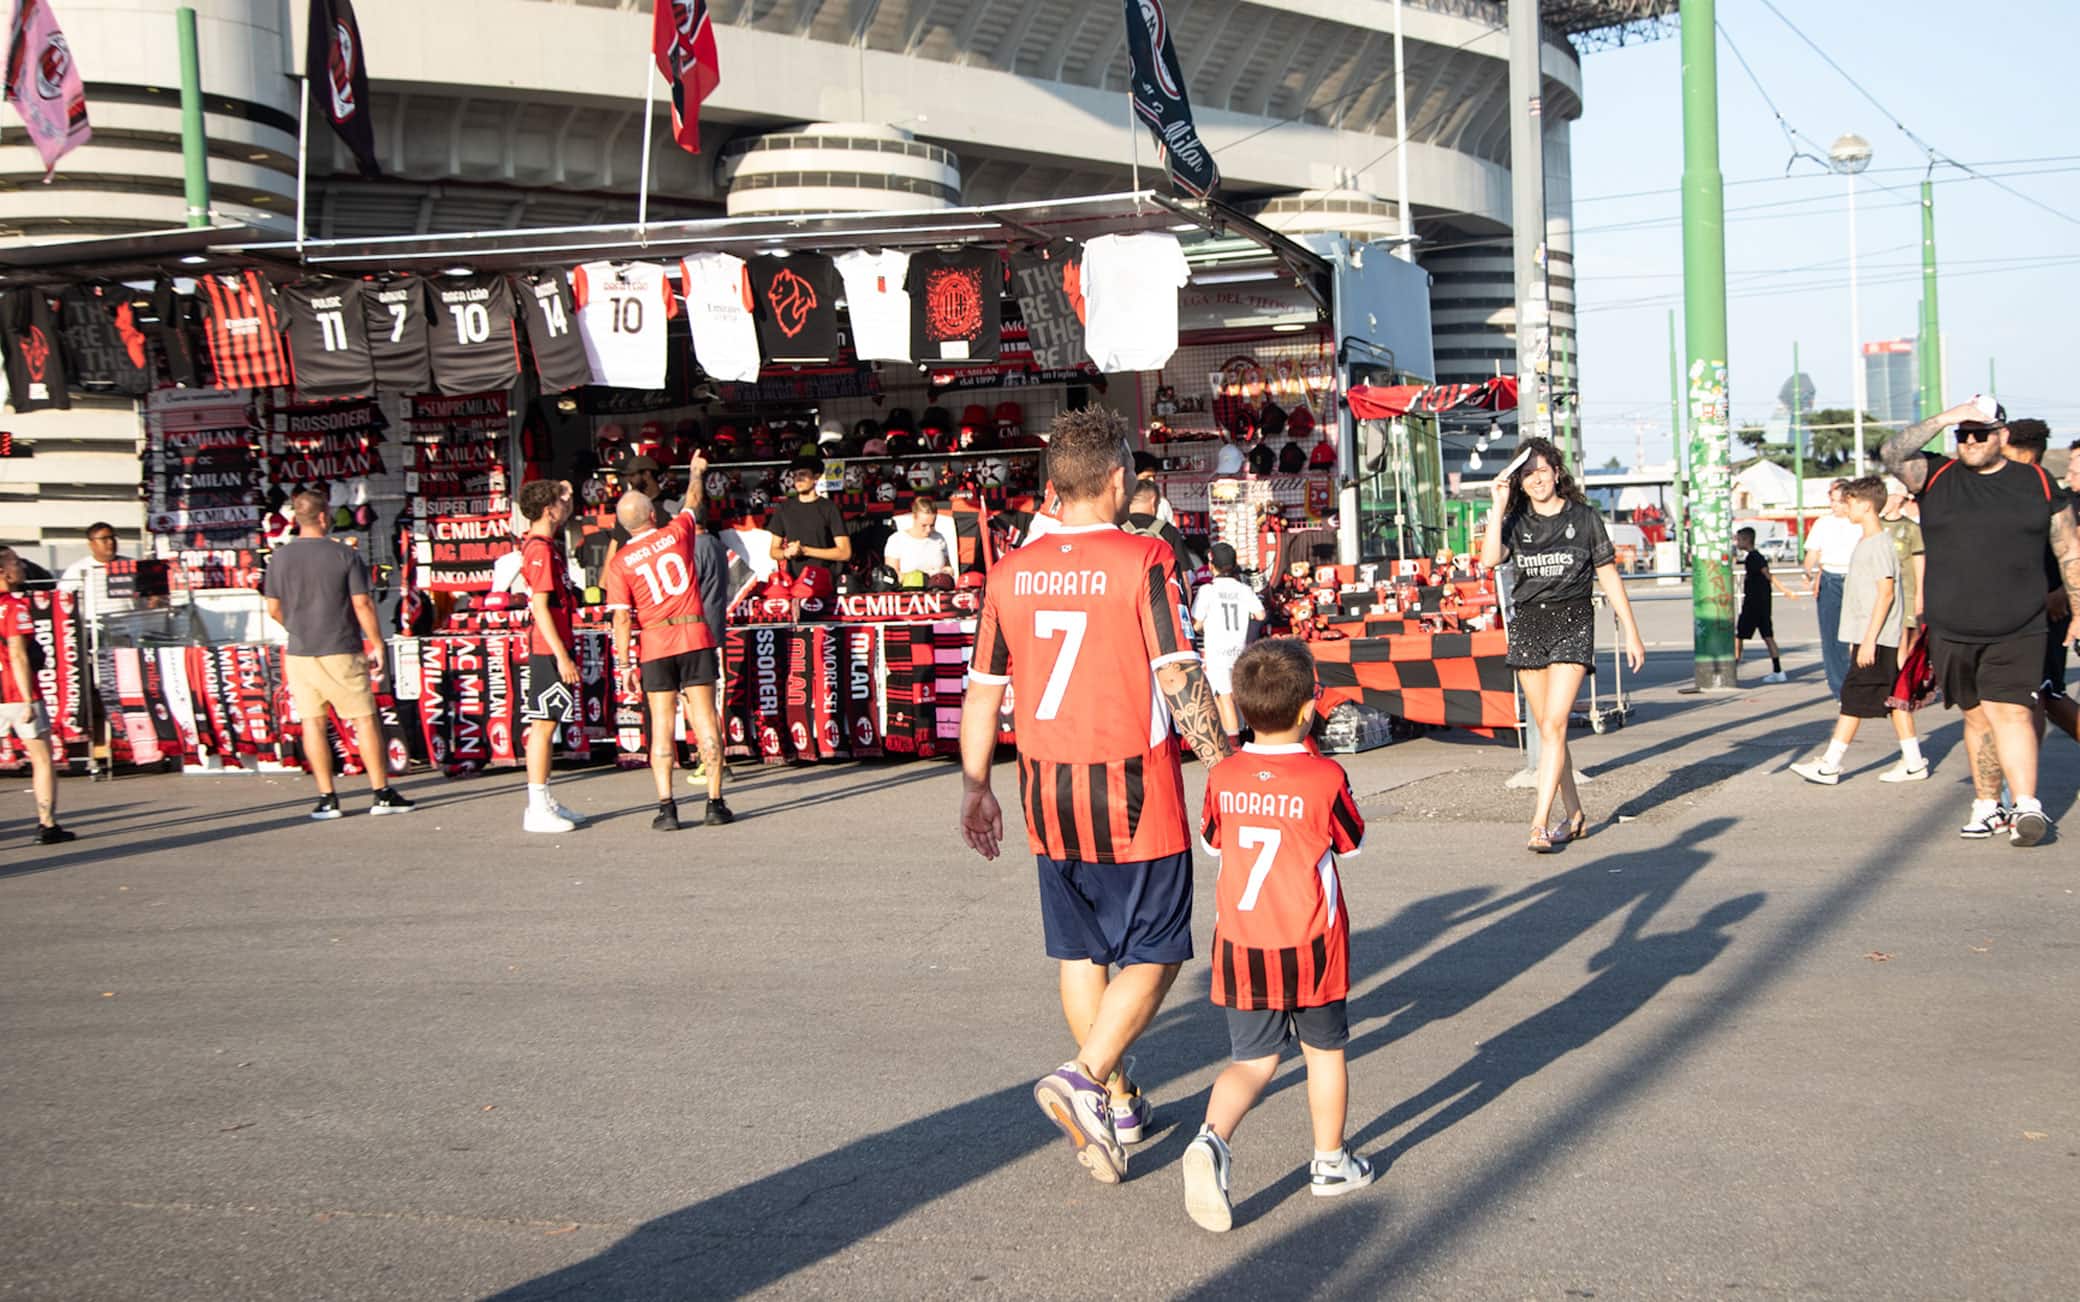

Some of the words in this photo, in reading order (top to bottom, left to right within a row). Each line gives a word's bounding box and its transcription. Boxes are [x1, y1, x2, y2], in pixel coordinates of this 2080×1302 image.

[1164, 120, 1204, 173] Milan
[316, 311, 348, 352] 11
[387, 303, 407, 343] 7
[451, 302, 490, 345] 10
[539, 294, 569, 338] 14
[609, 296, 643, 334] 10
[290, 407, 371, 432] ROSSONERI
[427, 500, 467, 515] SUPER
[470, 497, 510, 513] MILAN
[431, 570, 467, 584] UNICO
[467, 569, 494, 583] AMO
[634, 552, 689, 606] 10
[1516, 551, 1574, 568] Emirates
[1014, 569, 1107, 596] MORATA
[1221, 602, 1239, 631] 11
[62, 619, 79, 661] UNICO
[34, 619, 59, 724] ROSSONER
[218, 651, 240, 703] MILAN
[725, 629, 745, 706] MILAN
[787, 638, 807, 706] MILAN
[822, 634, 837, 690] AMORE
[850, 633, 870, 699] MILAN
[1035, 609, 1087, 721] 7
[422, 646, 444, 725] MILAN
[823, 691, 838, 713] SEI
[1219, 790, 1304, 819] MORATA
[1237, 825, 1281, 912] 7
